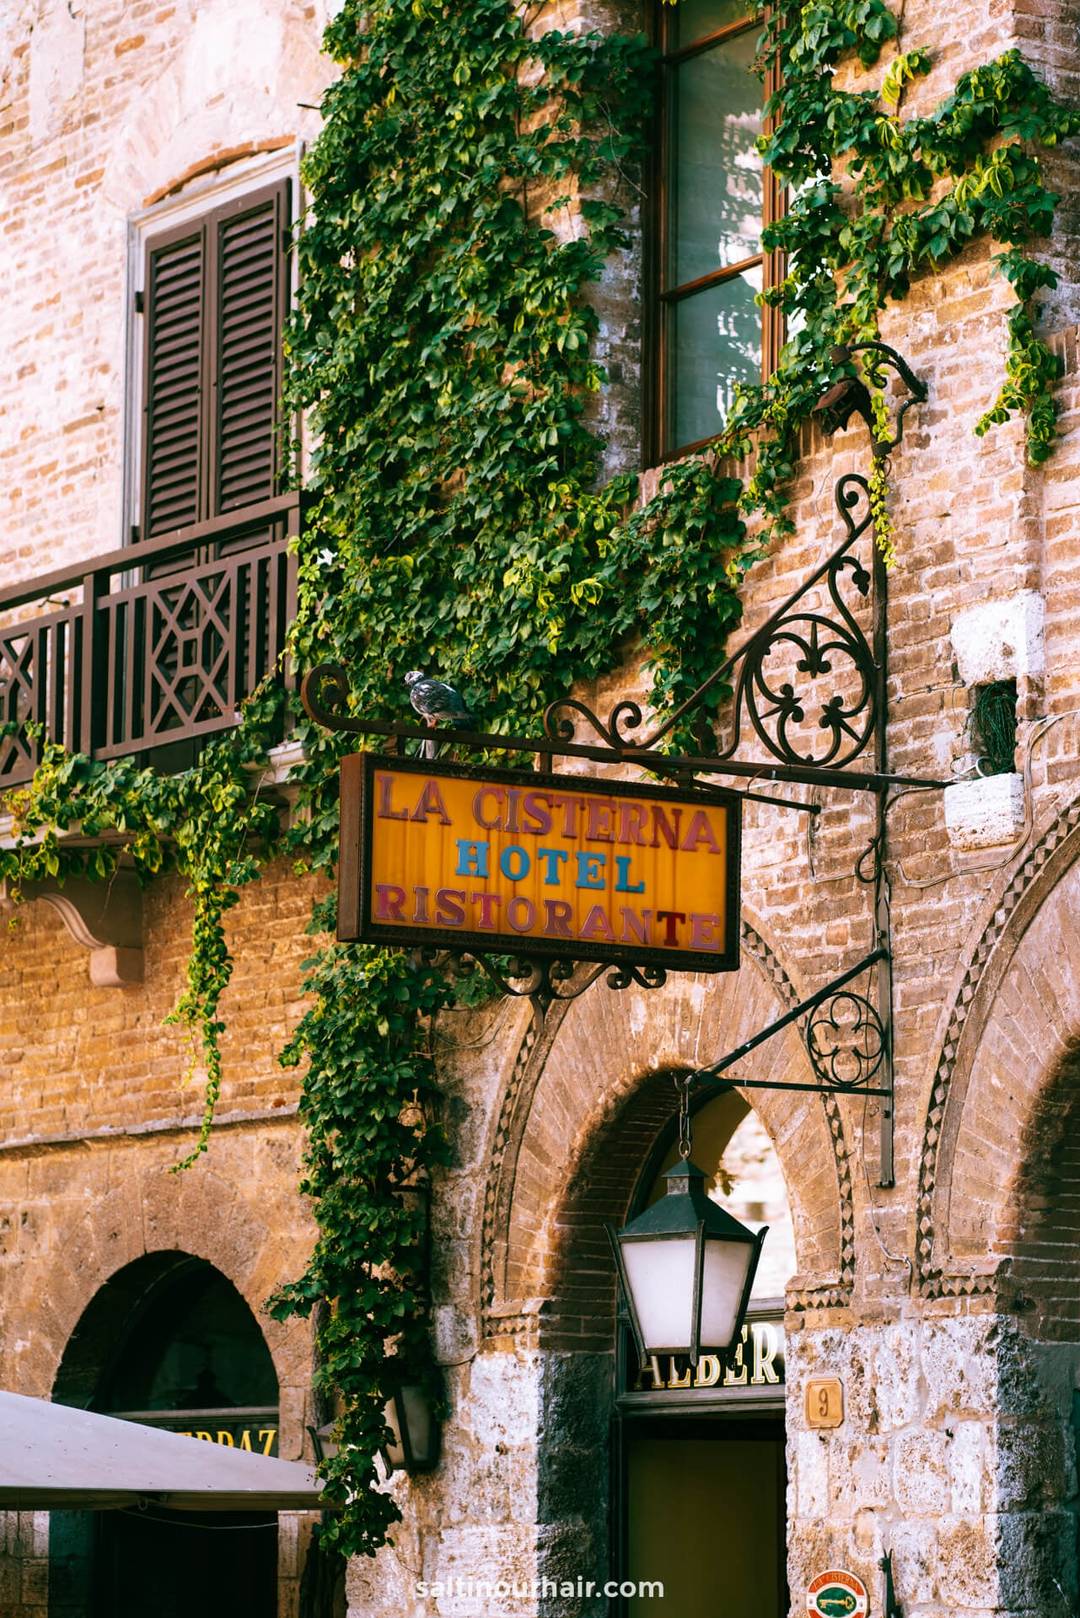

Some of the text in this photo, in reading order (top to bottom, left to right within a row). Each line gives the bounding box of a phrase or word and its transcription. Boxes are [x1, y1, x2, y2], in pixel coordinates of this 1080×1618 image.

[378, 776, 721, 854] LA CISTERNA
[455, 839, 645, 893] HOTEL
[375, 883, 721, 950] RISTORANTE
[818, 1388, 829, 1417] 9
